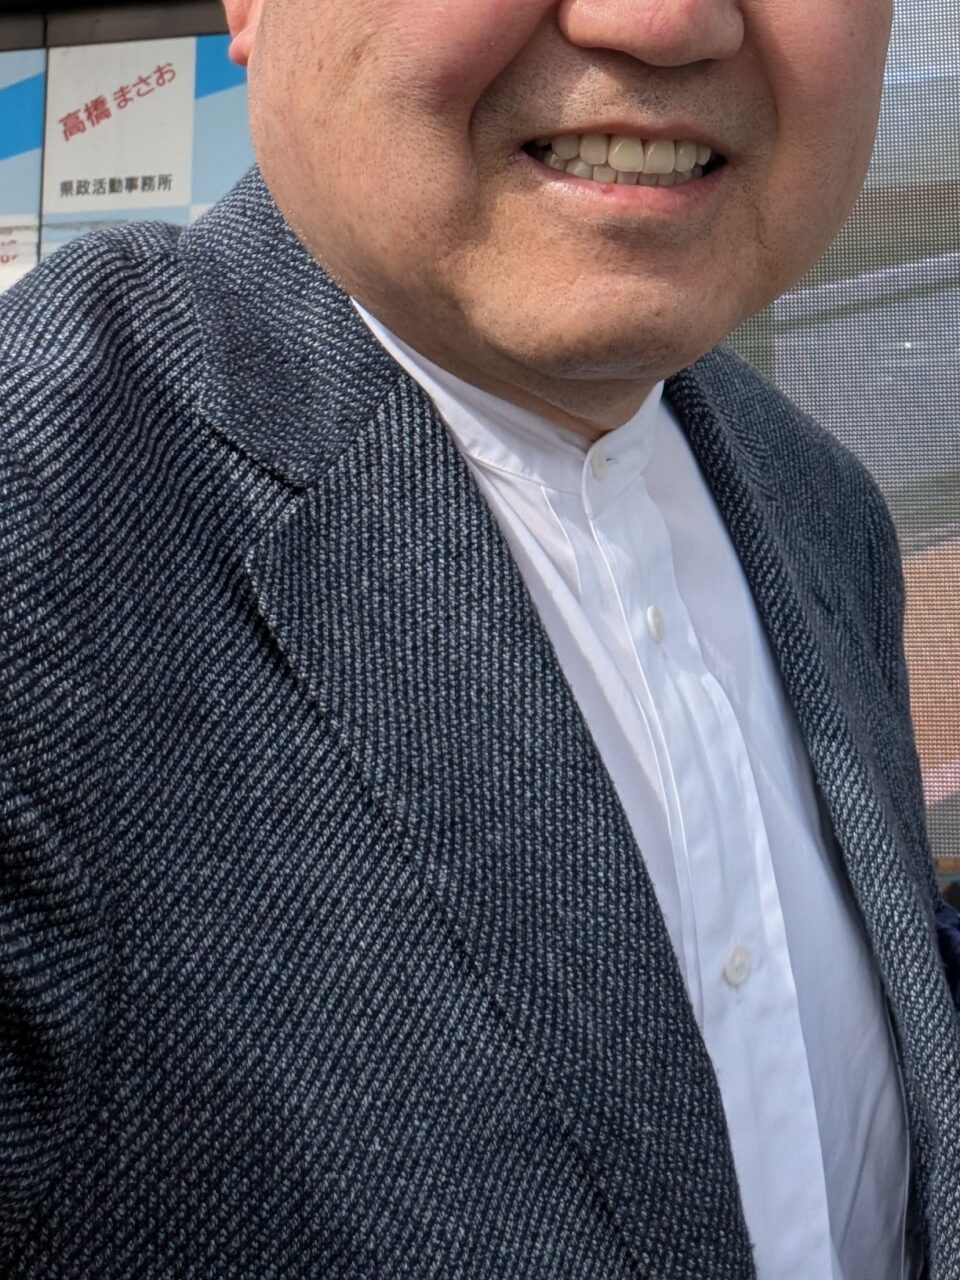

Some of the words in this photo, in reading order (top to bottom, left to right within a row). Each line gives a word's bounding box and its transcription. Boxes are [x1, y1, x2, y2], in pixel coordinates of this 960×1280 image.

[60, 174, 173, 197] 県政活動事務所
